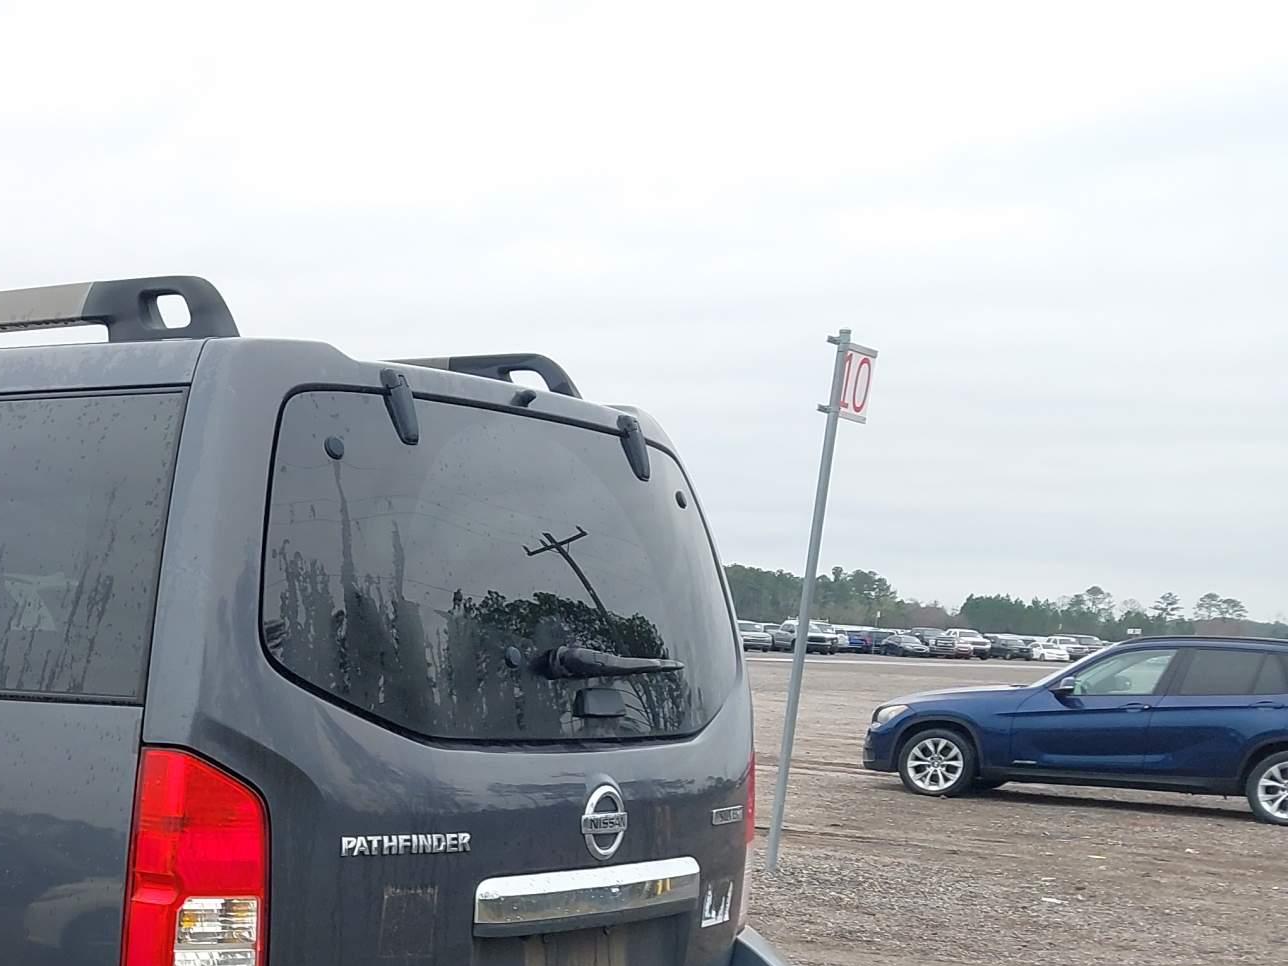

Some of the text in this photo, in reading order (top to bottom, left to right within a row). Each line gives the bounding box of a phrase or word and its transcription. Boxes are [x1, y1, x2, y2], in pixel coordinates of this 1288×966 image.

[840, 353, 871, 412] 10
[589, 814, 626, 830] NISSAN
[340, 832, 472, 857] PATHFINDER
